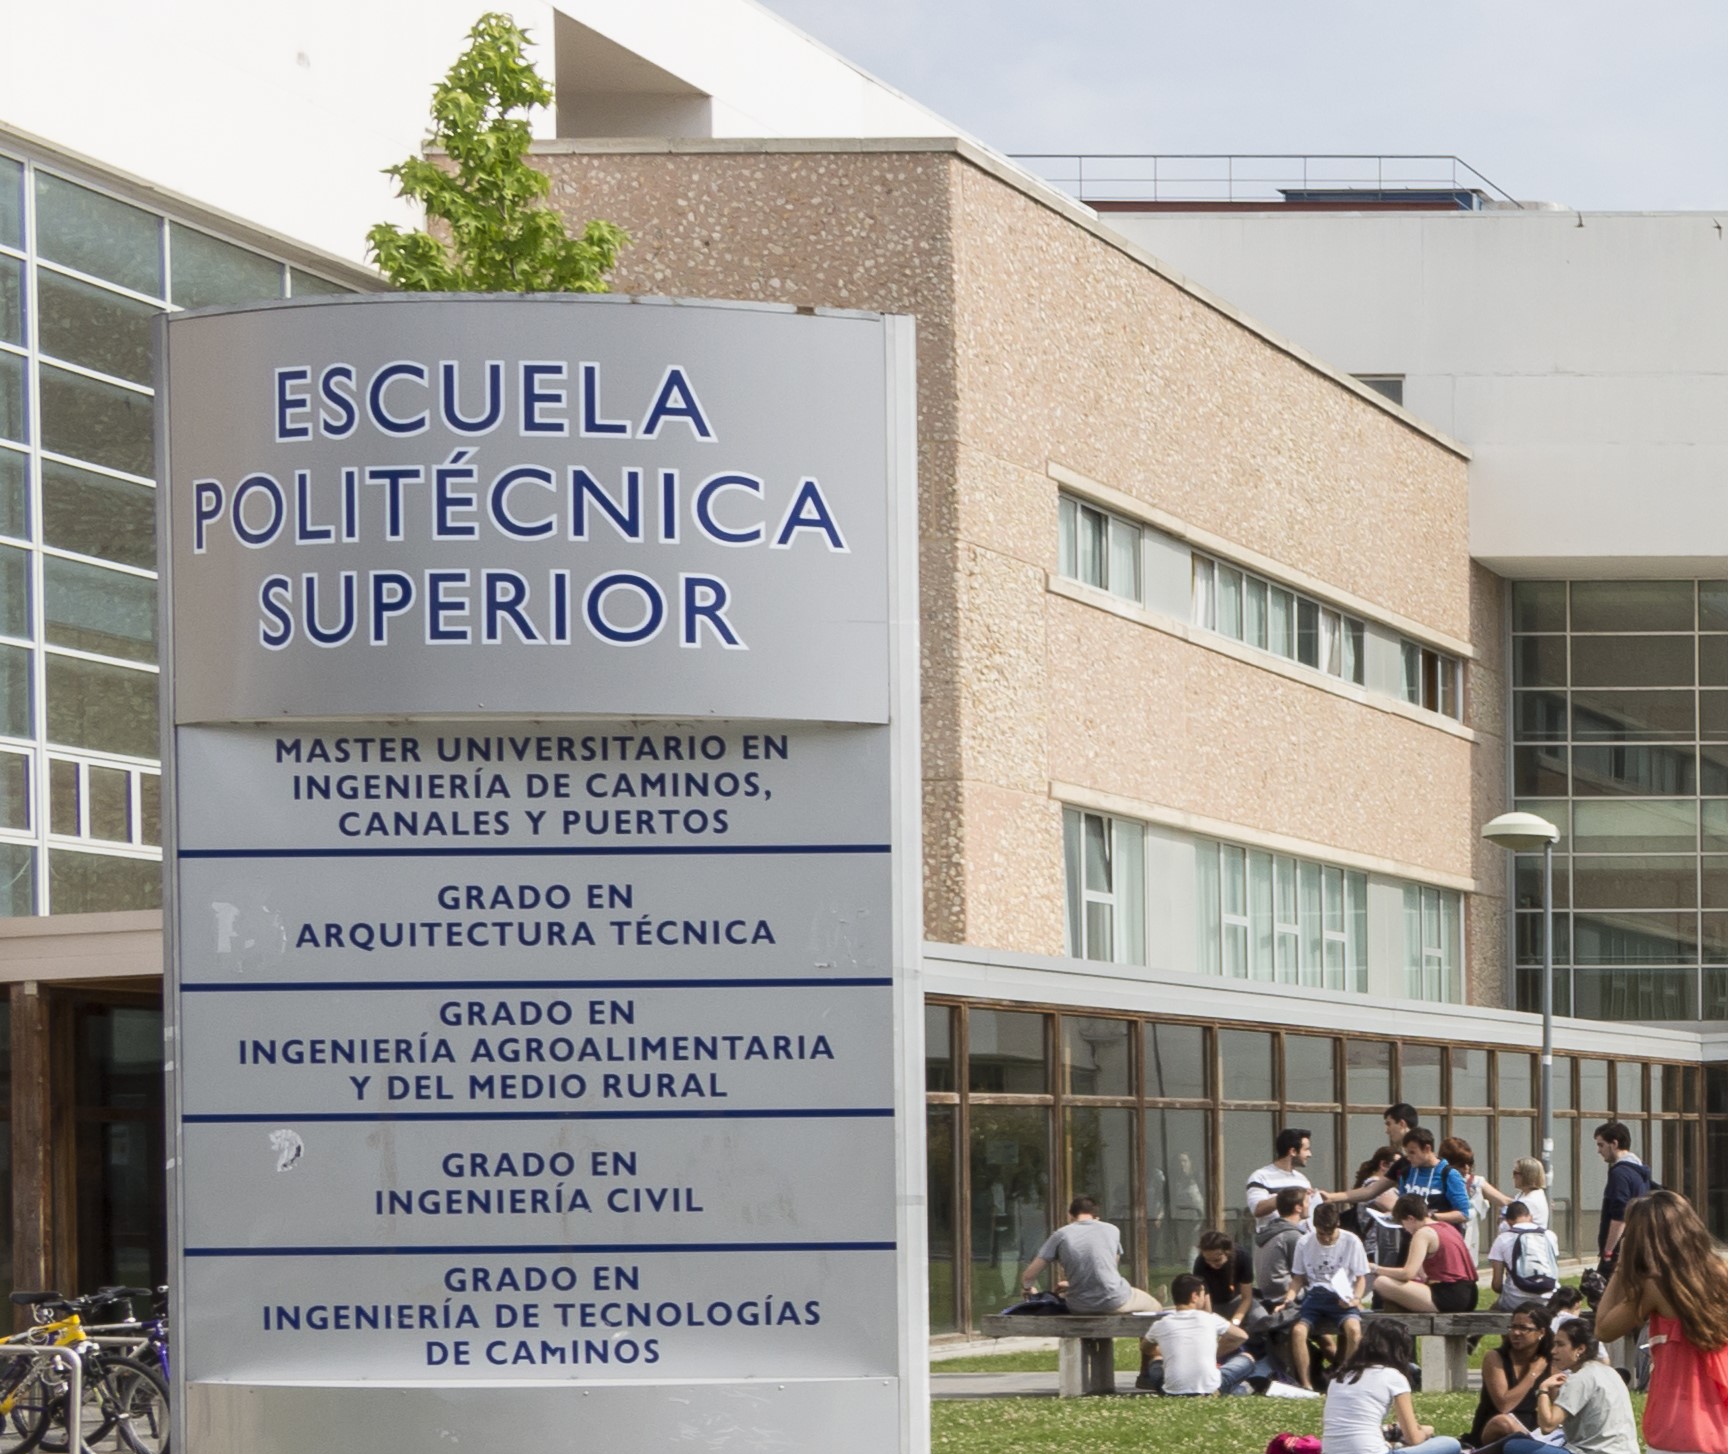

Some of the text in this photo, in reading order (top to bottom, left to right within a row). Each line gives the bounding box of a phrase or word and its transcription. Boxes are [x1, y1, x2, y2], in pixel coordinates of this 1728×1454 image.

[274, 360, 714, 443] ESCUELA
[191, 447, 847, 553] POLITÉCNICA
[258, 568, 742, 650] SUPERIOR
[276, 736, 787, 762] MASTER UNIVERSITARIO EN
[294, 769, 771, 800] INGENIERÍA DE CAMINOS,
[339, 809, 728, 836] CANALES Y PUERTOS
[438, 885, 632, 909] GRADO EN
[296, 915, 775, 951] ARQUITECTURA TÉCNICA
[440, 1001, 633, 1026] GRADO EN
[240, 1032, 834, 1064] INGENIERÍA AGROALIMENTARIA
[350, 1073, 727, 1100] Y DEL MEDIO RURAL
[443, 1152, 636, 1177] GRADO EN
[377, 1183, 703, 1214] INGENIERÍA CIVIL
[445, 1267, 638, 1292] GRADO EN
[264, 1295, 820, 1330] INGENIERÍA DE TECNOLOGÍAS
[427, 1339, 658, 1365] DE CAMINOS
